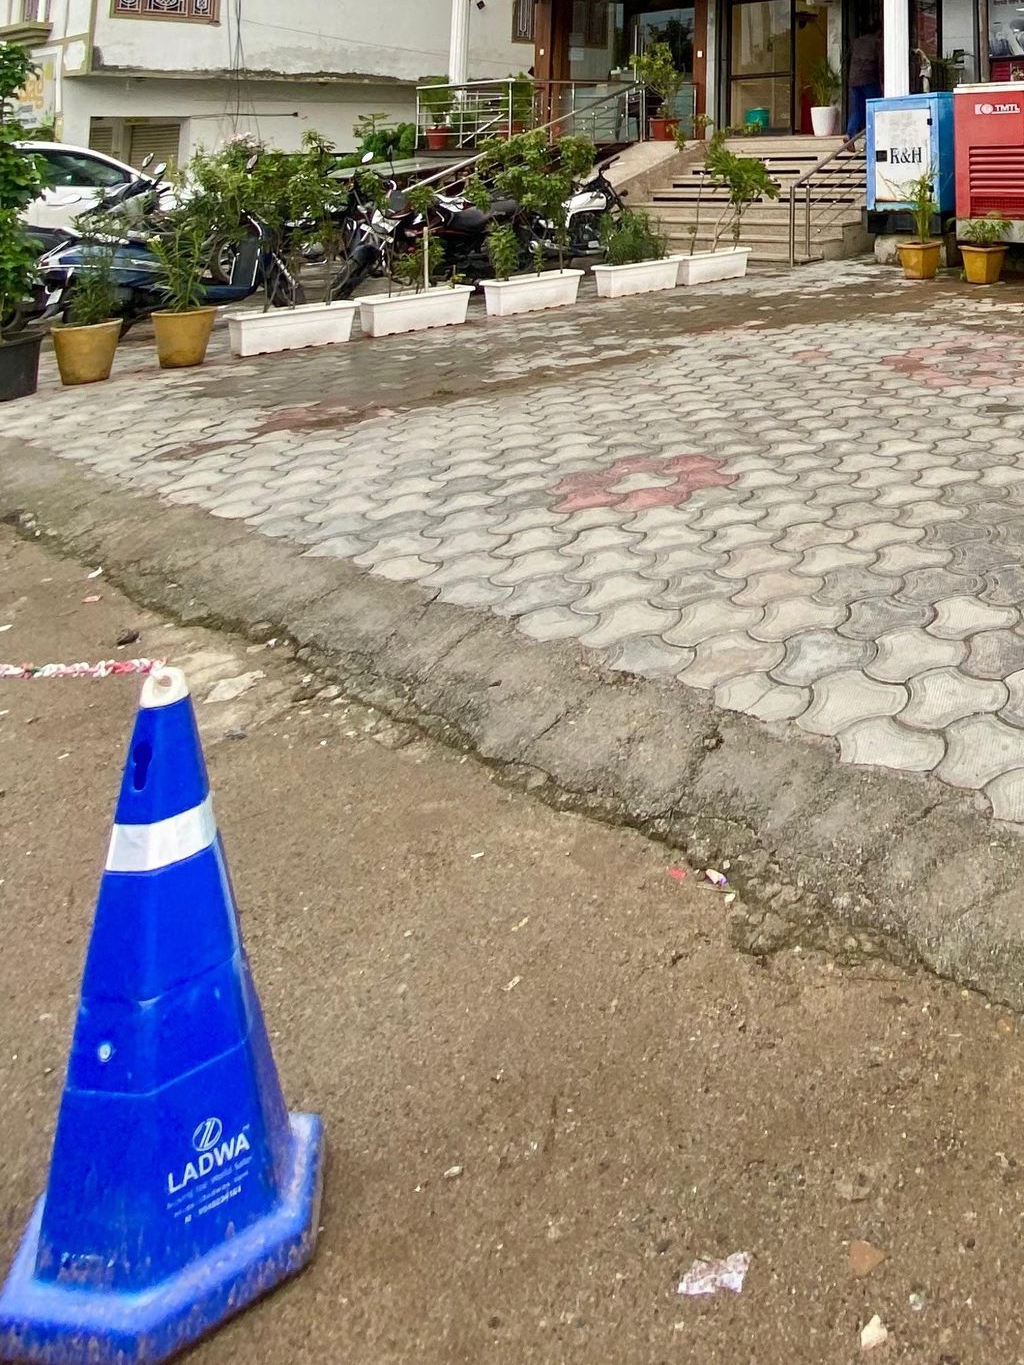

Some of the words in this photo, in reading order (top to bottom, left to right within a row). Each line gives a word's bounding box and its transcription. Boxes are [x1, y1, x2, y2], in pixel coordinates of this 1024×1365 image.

[994, 103, 1020, 112] TMTL
[890, 147, 922, 164] R&H
[168, 1133, 250, 1194] LADWA
